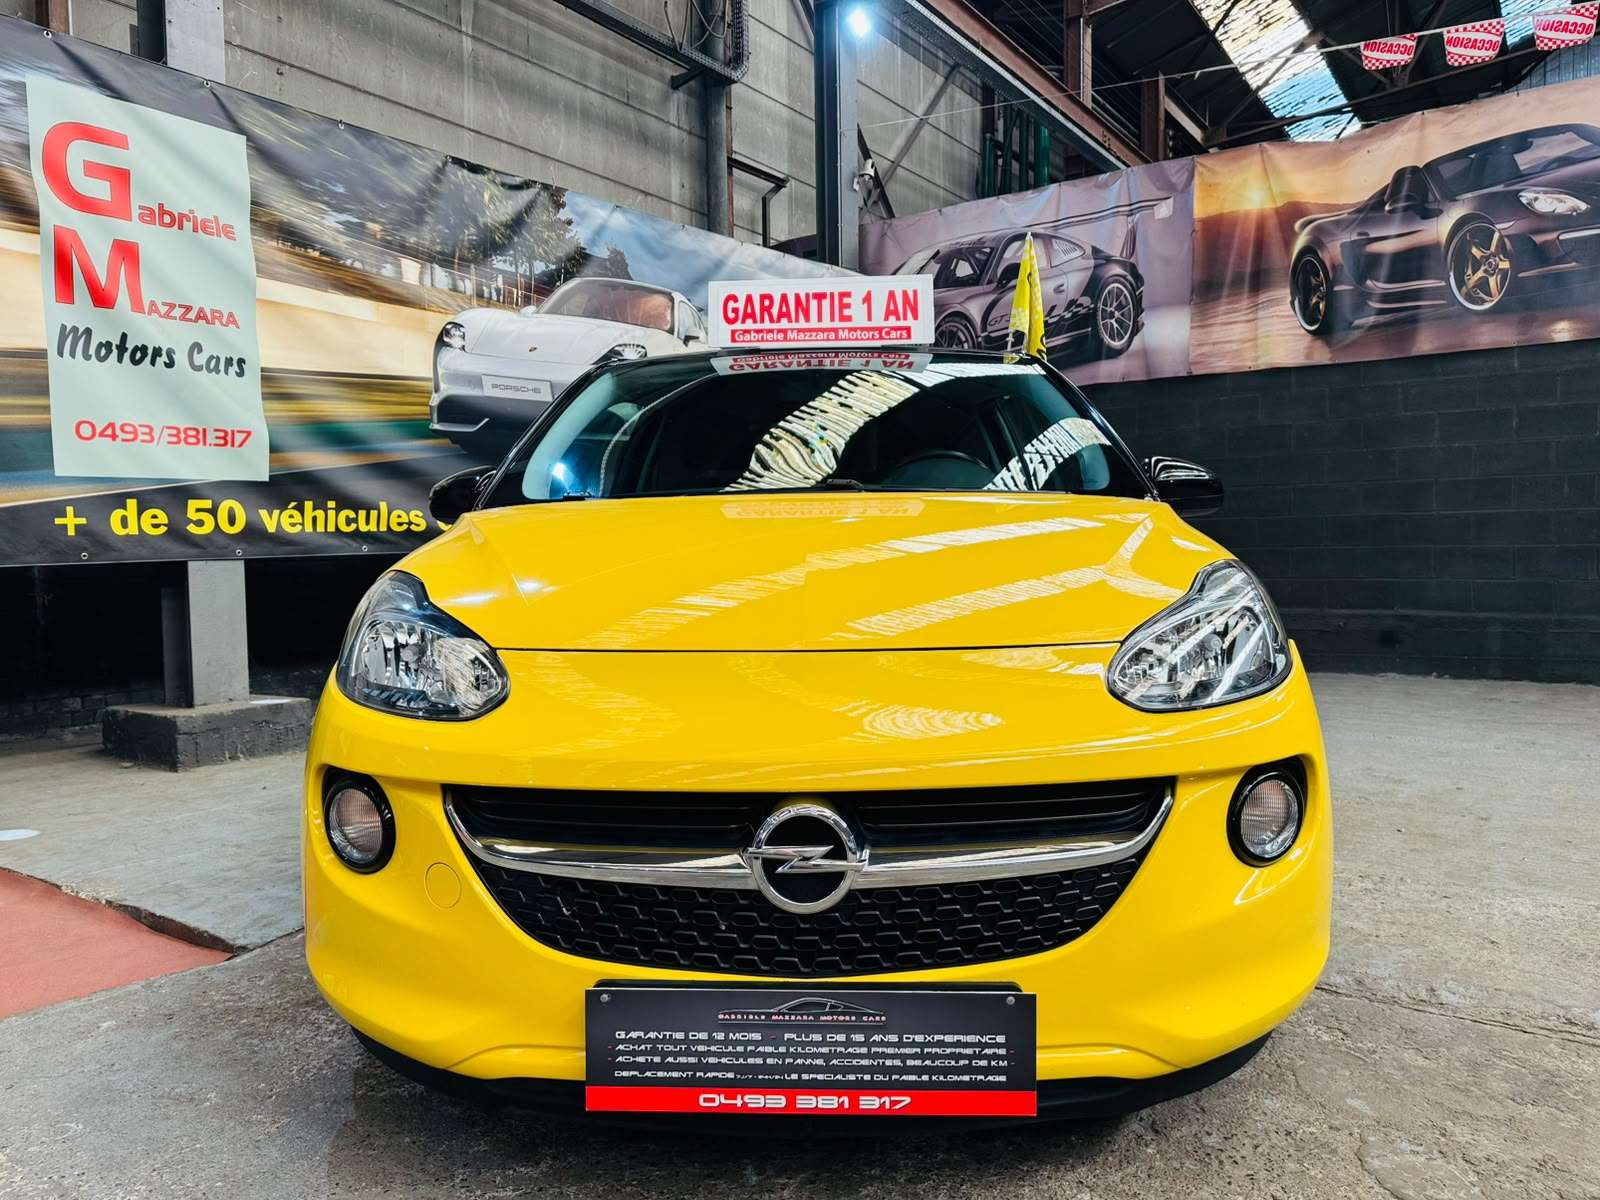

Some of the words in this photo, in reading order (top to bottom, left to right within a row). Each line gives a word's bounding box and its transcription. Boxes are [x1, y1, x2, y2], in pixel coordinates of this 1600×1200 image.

[722, 291, 852, 325] GARANTIE
[861, 290, 873, 322] 1
[884, 289, 919, 321] AN
[734, 330, 785, 342] Gabriele
[787, 328, 836, 341] Mazzara
[838, 327, 880, 340] Motors
[882, 327, 908, 340] Cars
[56, 323, 176, 370] Motors
[187, 340, 247, 379] Cars
[491, 383, 542, 394] PORSCHE
[74, 420, 253, 449] 0493/381.317
[109, 499, 169, 536] de
[186, 499, 247, 535] 50
[259, 501, 427, 534] véhicules
[615, 1031, 685, 1040] GARANTIE
[689, 1032, 709, 1040] DE
[712, 1032, 726, 1040] 12
[729, 1033, 763, 1041] MOIS
[784, 1033, 822, 1042] PLUS
[826, 1034, 846, 1042] DE
[850, 1034, 865, 1042] 15
[869, 1034, 899, 1042] ANS
[903, 1034, 1006, 1043] D'EXPERIENCE
[789, 1046, 868, 1054] KILOMETRAGE
[801, 1073, 871, 1081] SPECIALISTE
[932, 1074, 1007, 1082] KILOMETRAGE
[698, 1094, 787, 1109] 0493
[795, 1095, 849, 1109] 381
[859, 1096, 911, 1110] 317
